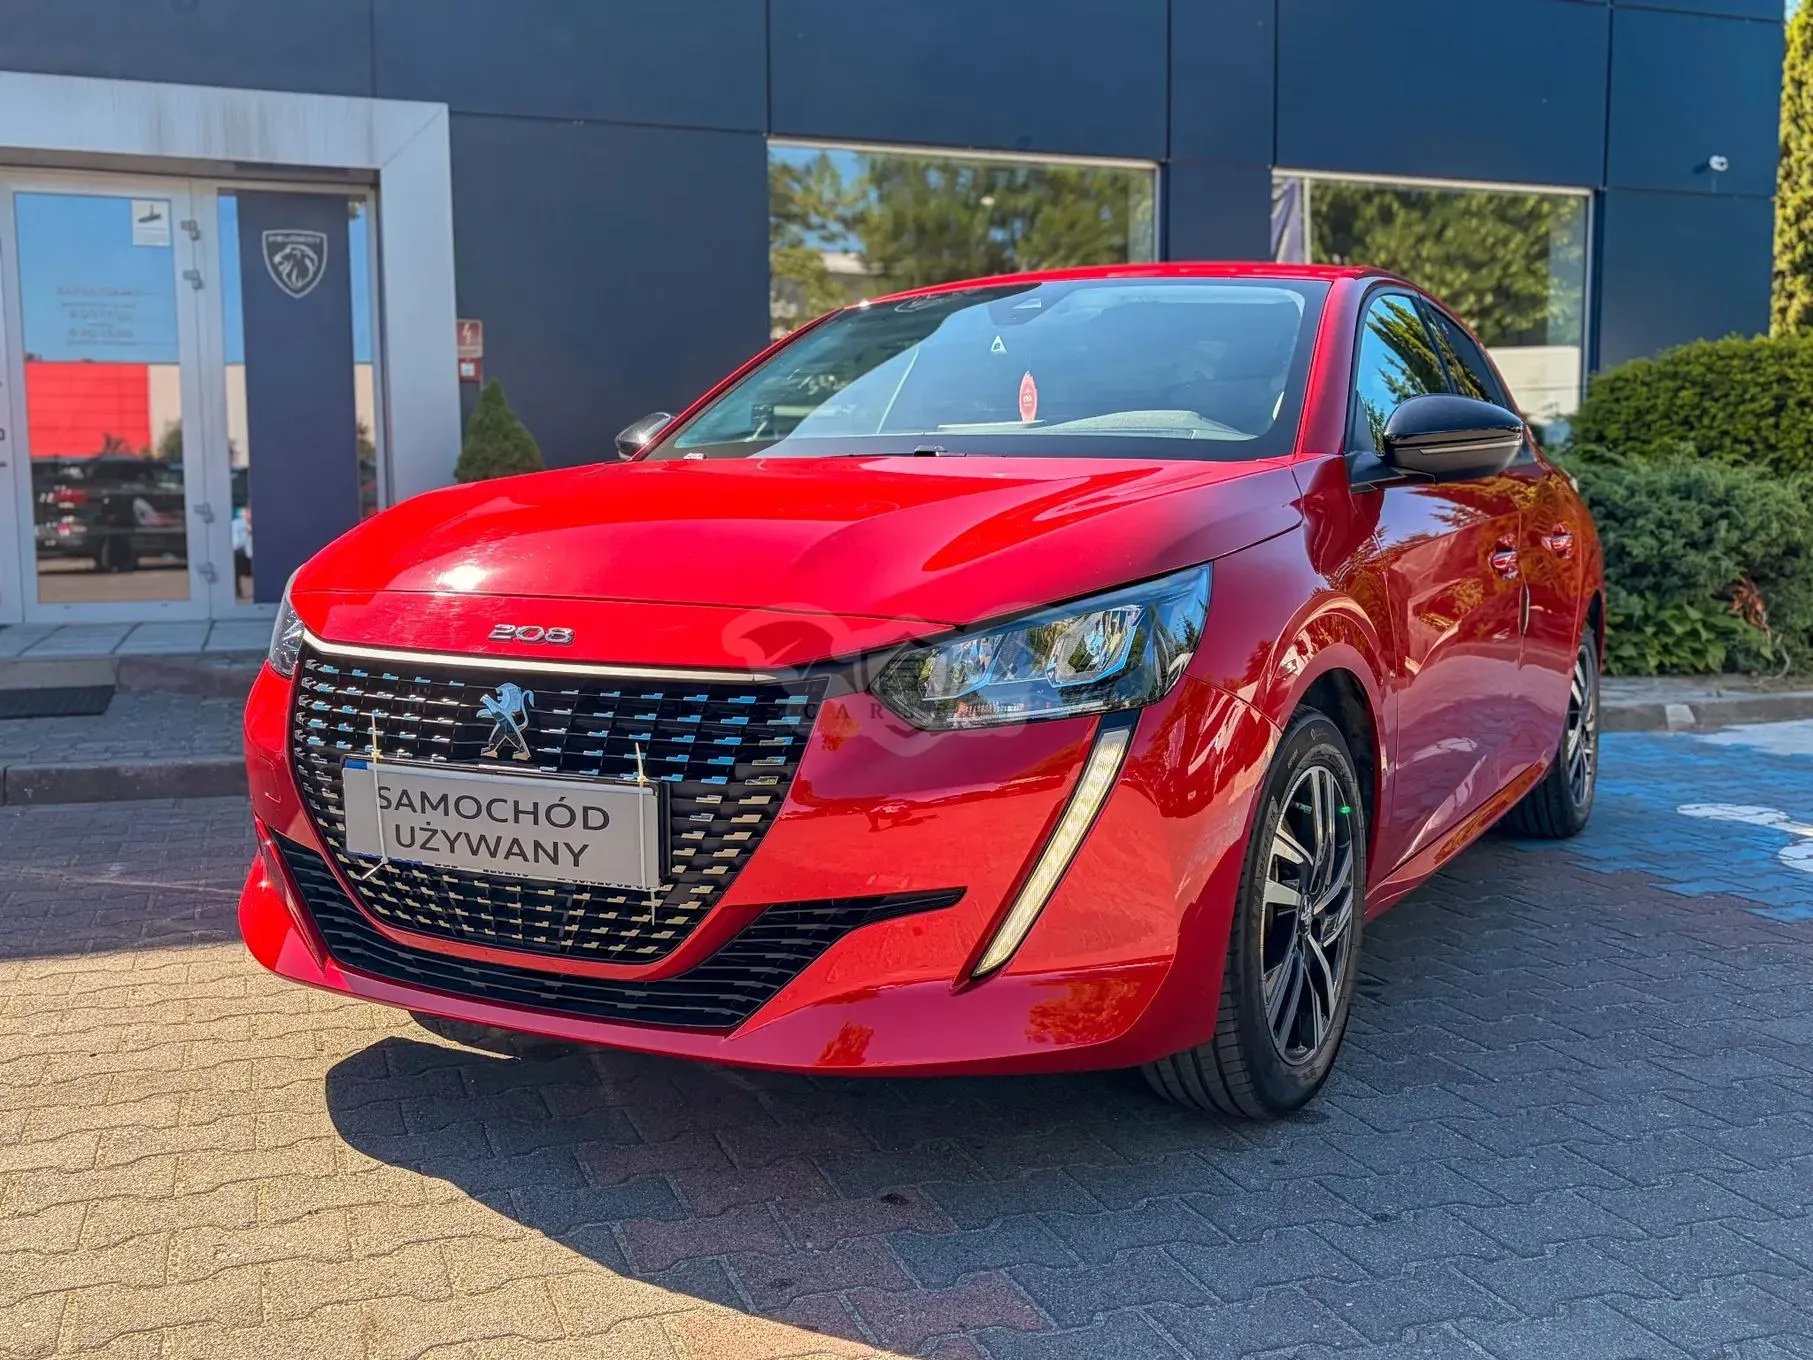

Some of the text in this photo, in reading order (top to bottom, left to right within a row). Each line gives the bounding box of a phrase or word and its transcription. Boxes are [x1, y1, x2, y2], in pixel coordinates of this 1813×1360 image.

[488, 623, 575, 646] 208
[377, 786, 611, 831] SAMOCHÓD
[395, 821, 589, 868] UŻYWANY
